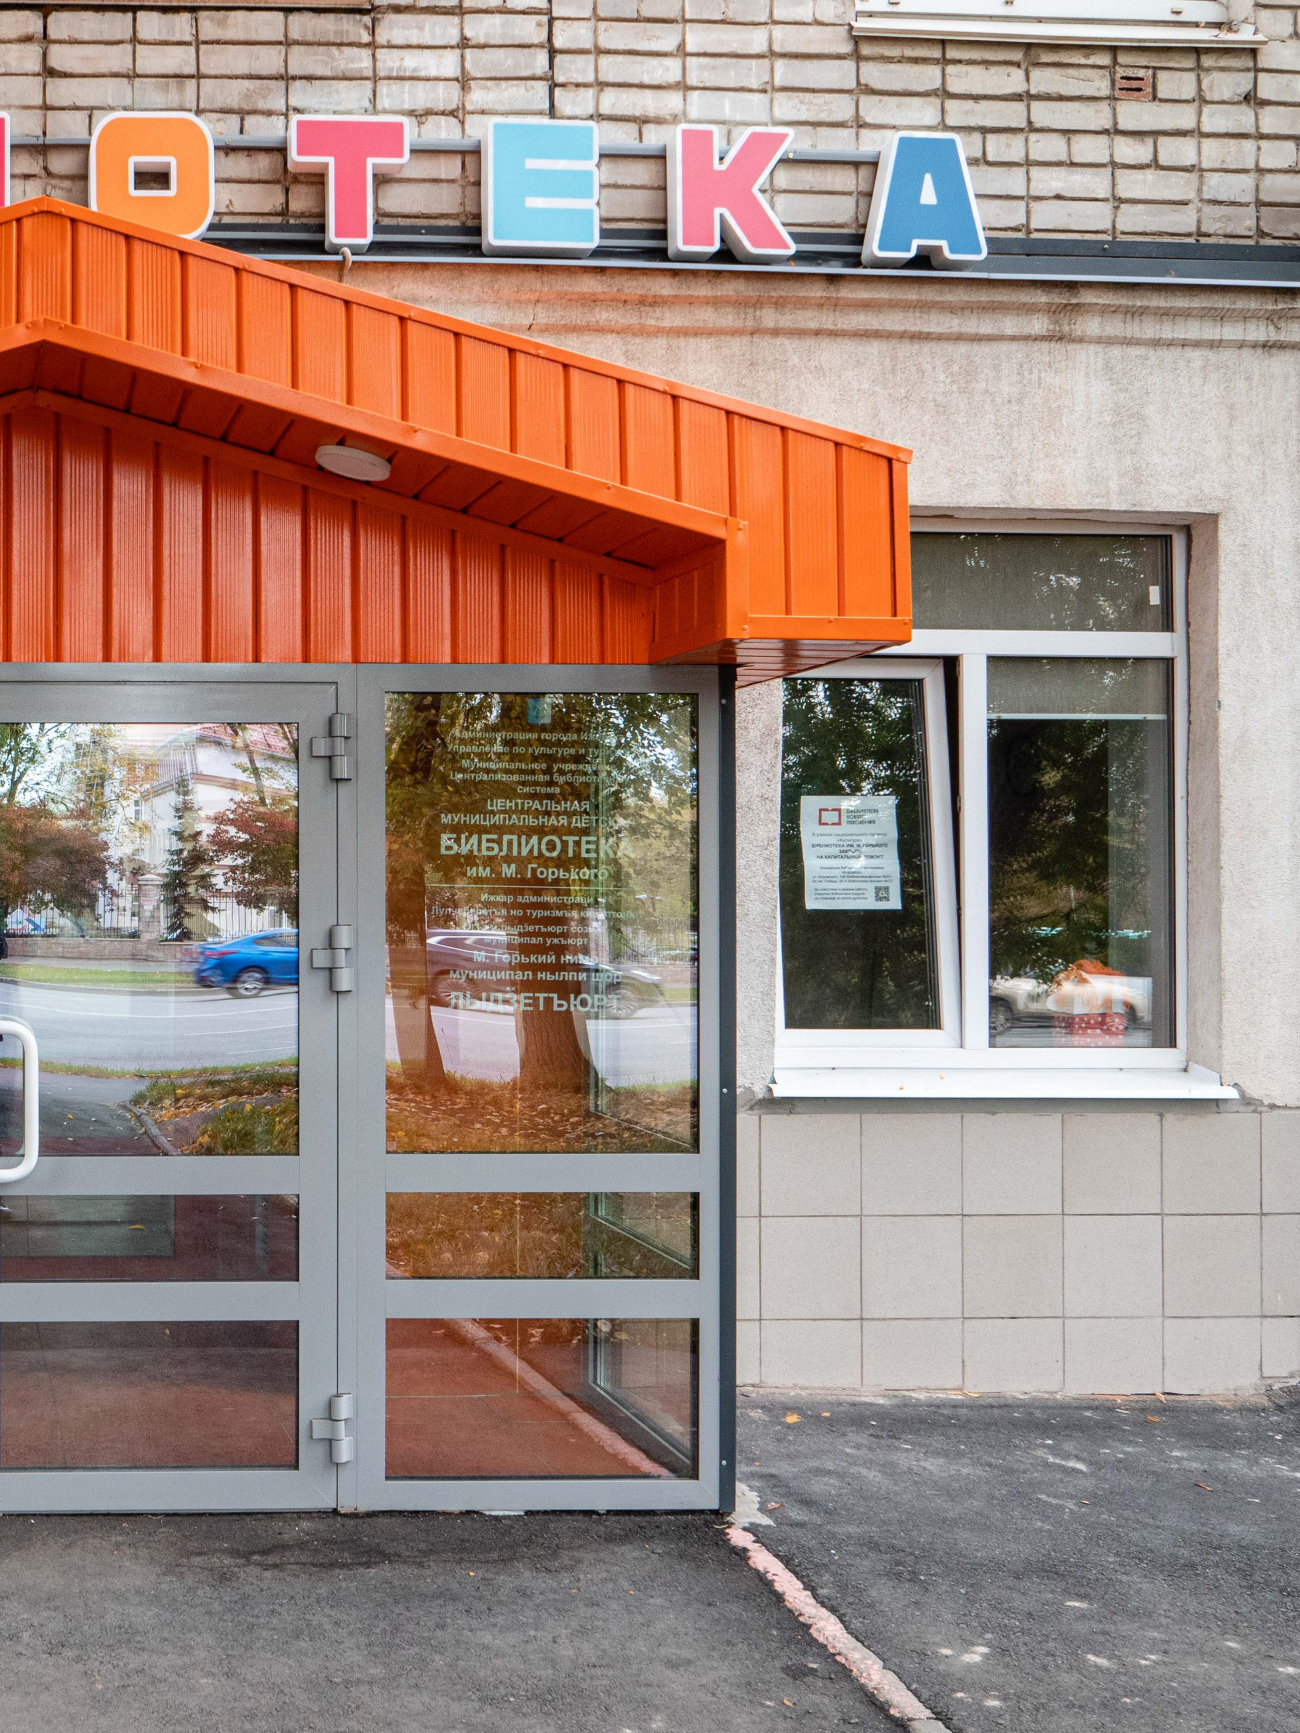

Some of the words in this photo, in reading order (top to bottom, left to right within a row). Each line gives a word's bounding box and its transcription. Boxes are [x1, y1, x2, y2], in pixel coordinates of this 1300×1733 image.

[541, 732, 578, 742] города
[513, 746, 526, 754] по
[529, 745, 575, 757] культуре
[461, 759, 547, 771] Муниципальное
[450, 771, 550, 783] Централизованная
[517, 786, 561, 795] система
[487, 798, 590, 813] ЦЕНТРАЛЬНАЯ
[441, 813, 568, 827] МУНИЦИПАЛЬНАЯ
[571, 815, 620, 829] ДЕТСК
[440, 833, 635, 859] БИБЛИОТЕКА
[466, 866, 496, 879] им.
[502, 863, 522, 879] М.
[527, 863, 609, 882] Горького
[480, 892, 514, 904] Ижкар
[510, 909, 524, 917] но
[545, 937, 589, 947] ужъюрт
[473, 950, 490, 962] М.
[495, 950, 556, 965] Горький
[449, 969, 533, 981] муниципал
[537, 971, 587, 981] нылпи
